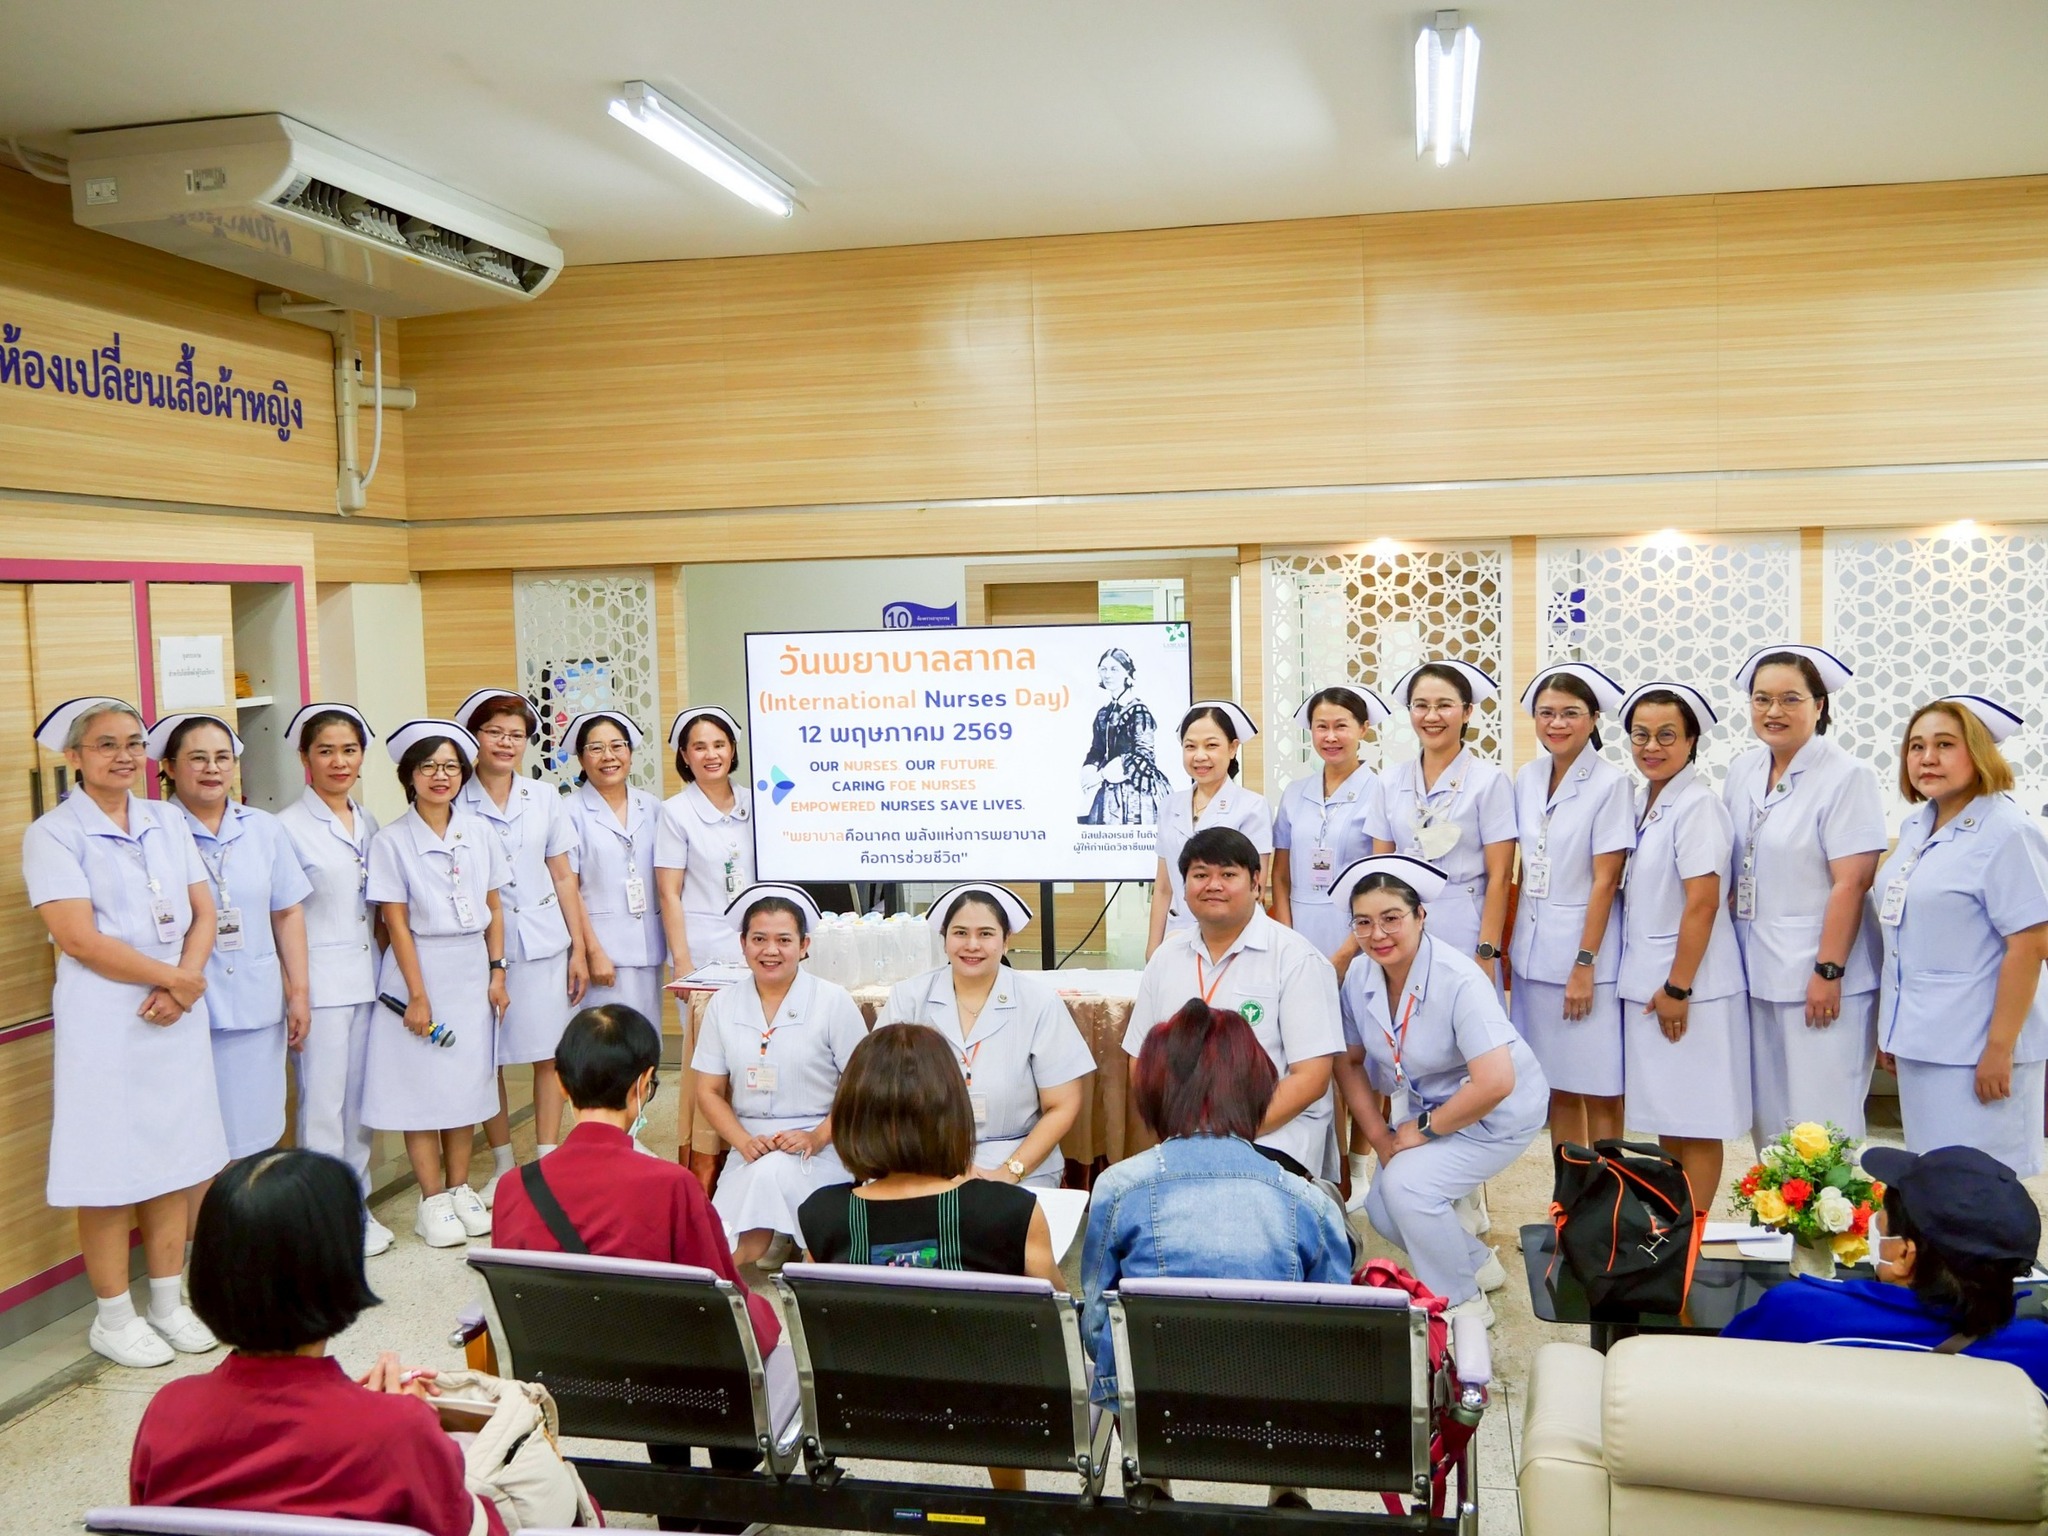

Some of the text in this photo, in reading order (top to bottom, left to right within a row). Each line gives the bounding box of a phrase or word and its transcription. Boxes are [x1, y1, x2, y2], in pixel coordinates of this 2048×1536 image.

[0, 323, 303, 442] ห้องเปลี่ยนเสื้อผ้าหญิง
[887, 611, 909, 628] 10
[779, 644, 1036, 676] วันพยาบาลสากล
[759, 685, 1070, 714] (International Nurses Day)
[798, 721, 1014, 748] 12 พฤษภาคม 2569
[809, 758, 998, 772] OUR NURSES. OUR FUTURE.
[832, 778, 977, 792] CARING FOE NURSES
[790, 798, 1026, 813] EMPOWERED NURSES SAVE LIVES.
[905, 826, 1047, 842] พลังแห่งการพยาบาล
[860, 850, 968, 865] คือการช่วยชีวิต"
